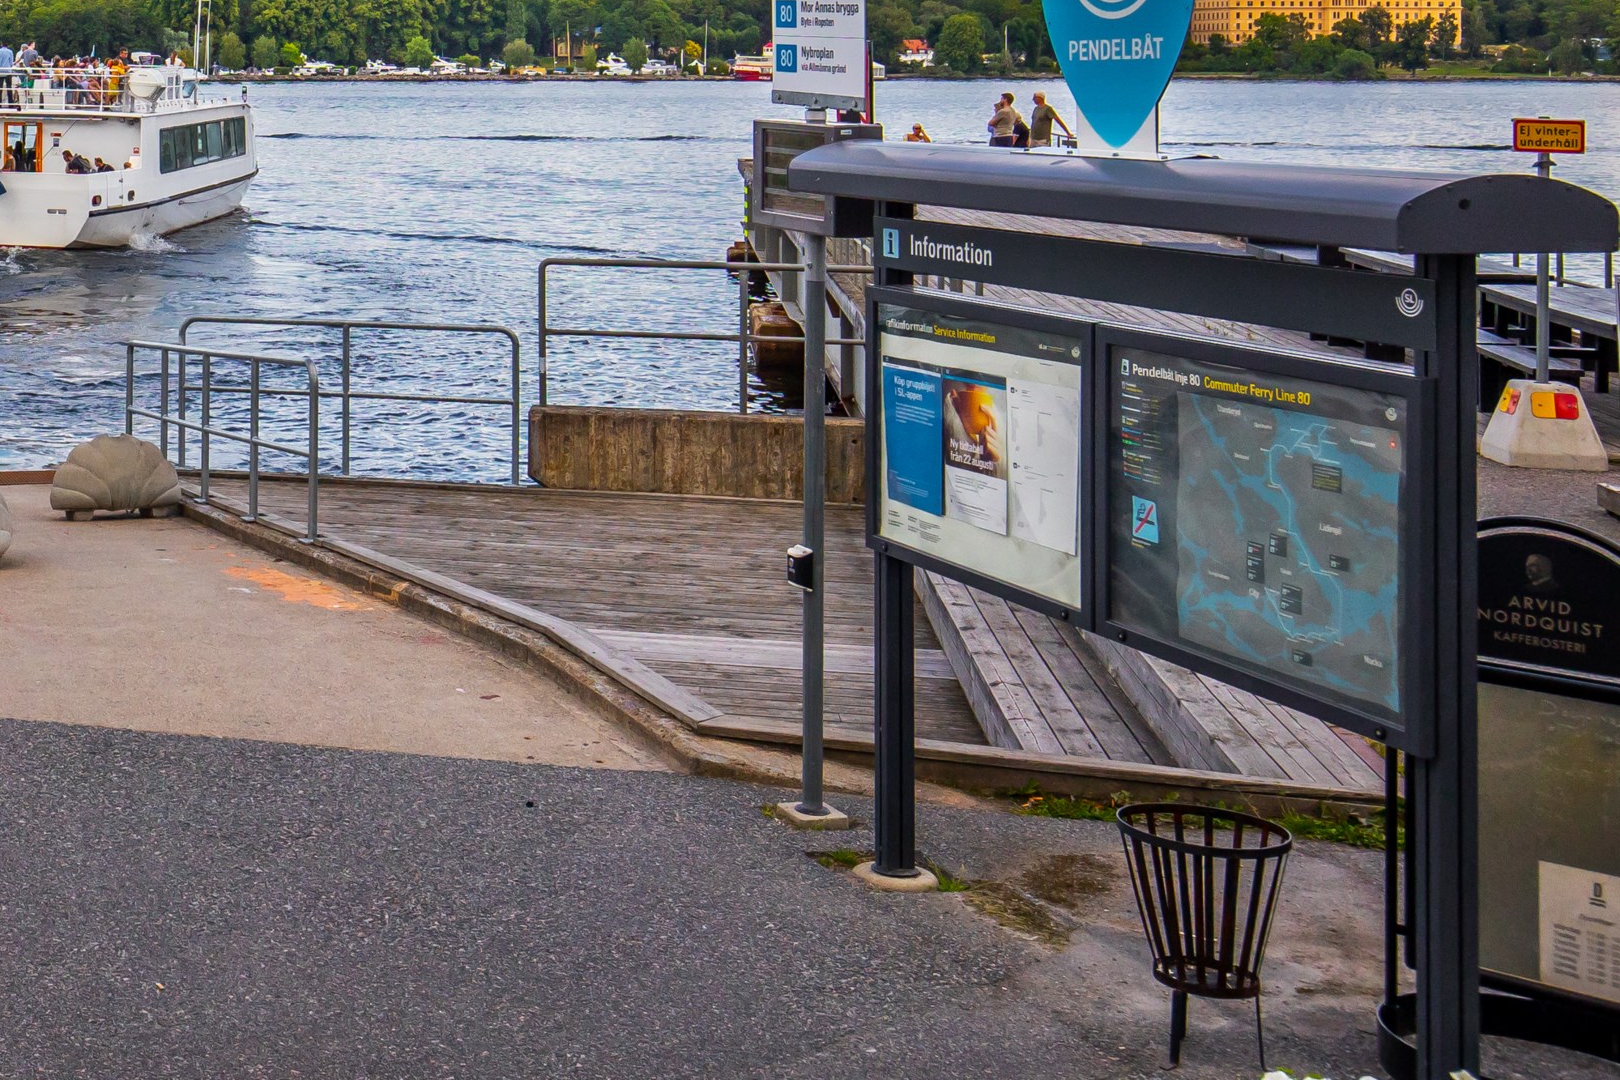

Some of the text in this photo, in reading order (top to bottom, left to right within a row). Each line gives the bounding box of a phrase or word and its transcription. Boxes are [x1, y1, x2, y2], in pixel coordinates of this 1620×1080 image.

[780, 1, 859, 22] 80 Mor Annas brygga
[815, 17, 835, 28] Ropsten
[780, 46, 834, 67] 80 Nybroplan
[1068, 32, 1164, 62] PENDELBÅT
[1519, 125, 1531, 137] Ej
[1520, 138, 1578, 148] underhåll
[910, 234, 993, 267] Information
[933, 324, 956, 338] Service
[956, 328, 996, 344] Information
[1132, 363, 1175, 382] Pendelbåt
[1189, 373, 1201, 387] 80
[1203, 376, 1248, 395] Commuter
[1249, 383, 1274, 402] Ferry
[1275, 387, 1296, 403] Line
[1297, 391, 1311, 406] 80
[949, 438, 959, 451] Ny
[949, 450, 964, 463] från
[963, 453, 972, 465] 22
[1508, 595, 1571, 615] ARVID
[1476, 607, 1604, 639] NORDQUIST
[1493, 630, 1587, 654] KAFFEROSTERI
